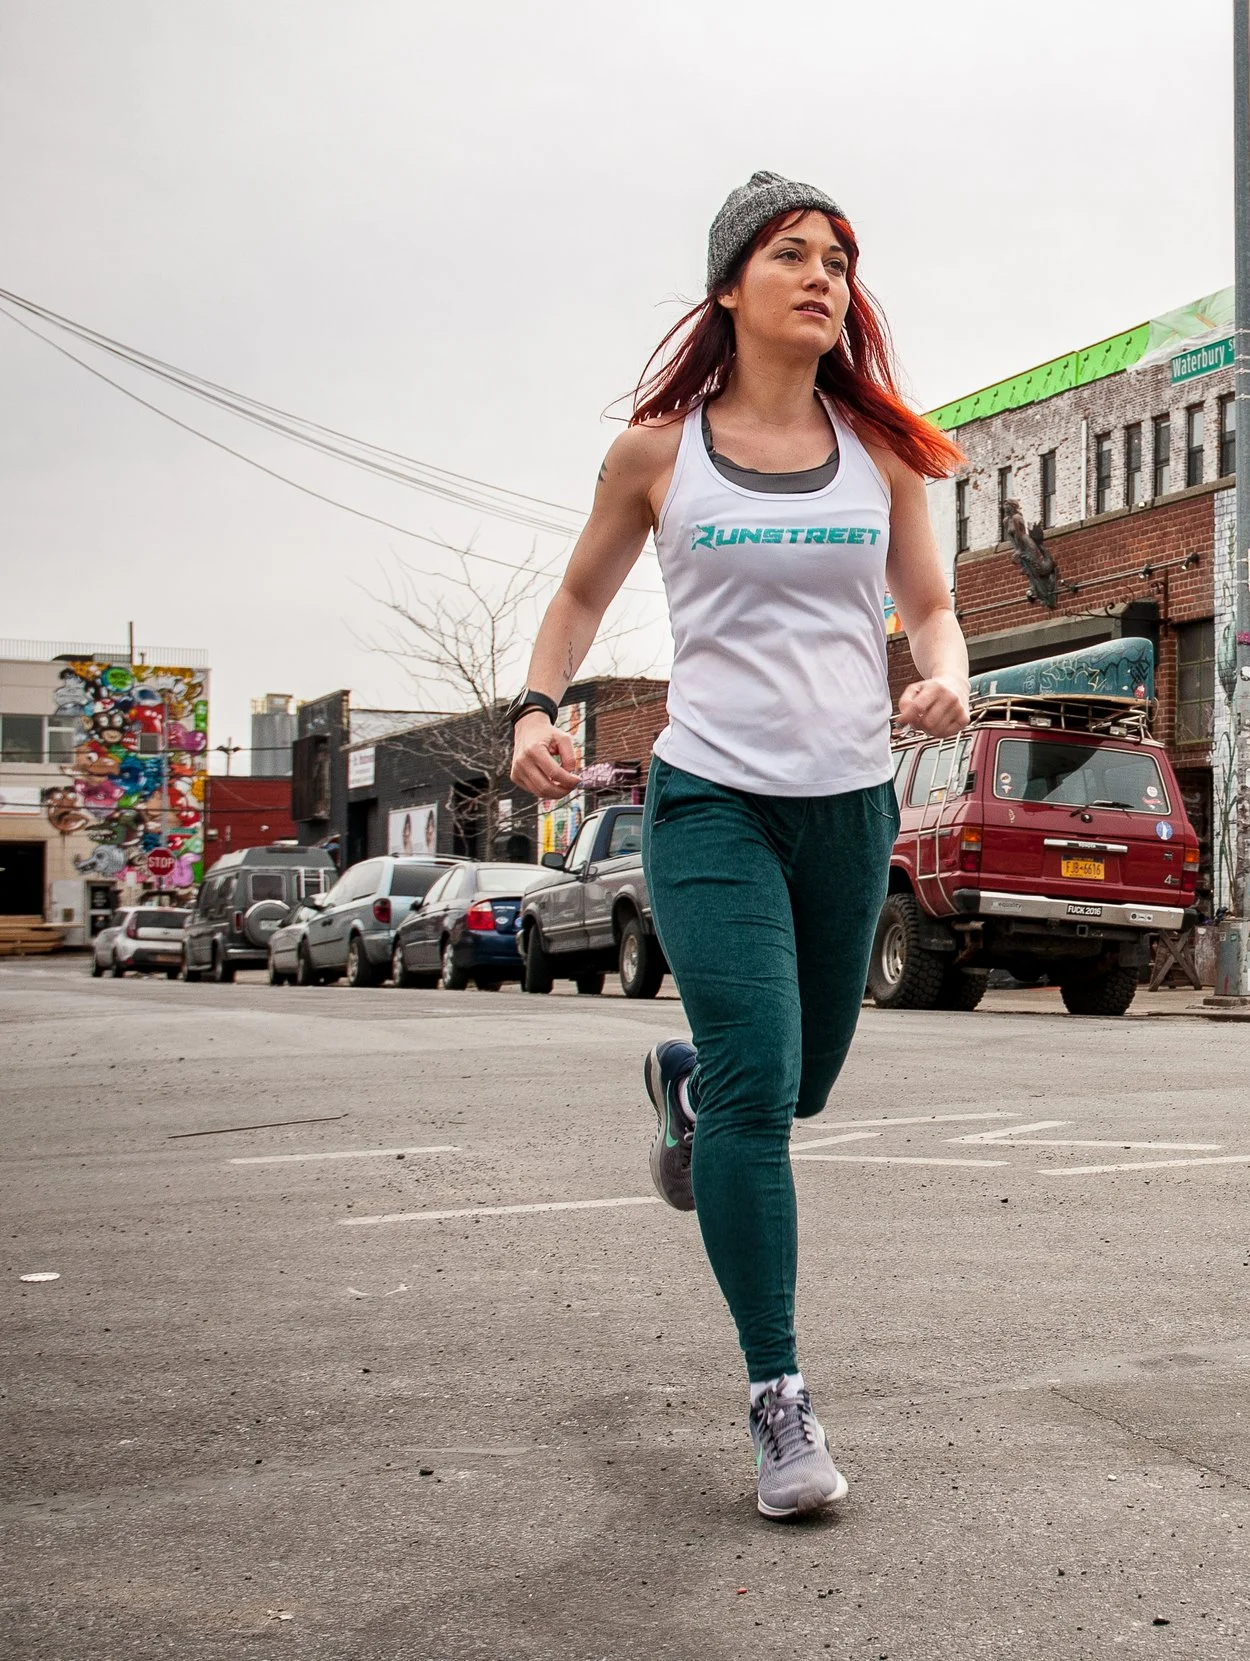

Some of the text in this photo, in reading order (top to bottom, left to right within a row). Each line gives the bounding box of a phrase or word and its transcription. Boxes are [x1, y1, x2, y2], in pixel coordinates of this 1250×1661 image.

[1172, 345, 1225, 378] Waterbury
[691, 524, 881, 552] RUNSTREET
[148, 856, 175, 868] STOP
[1067, 904, 1102, 916] FUCK 2016
